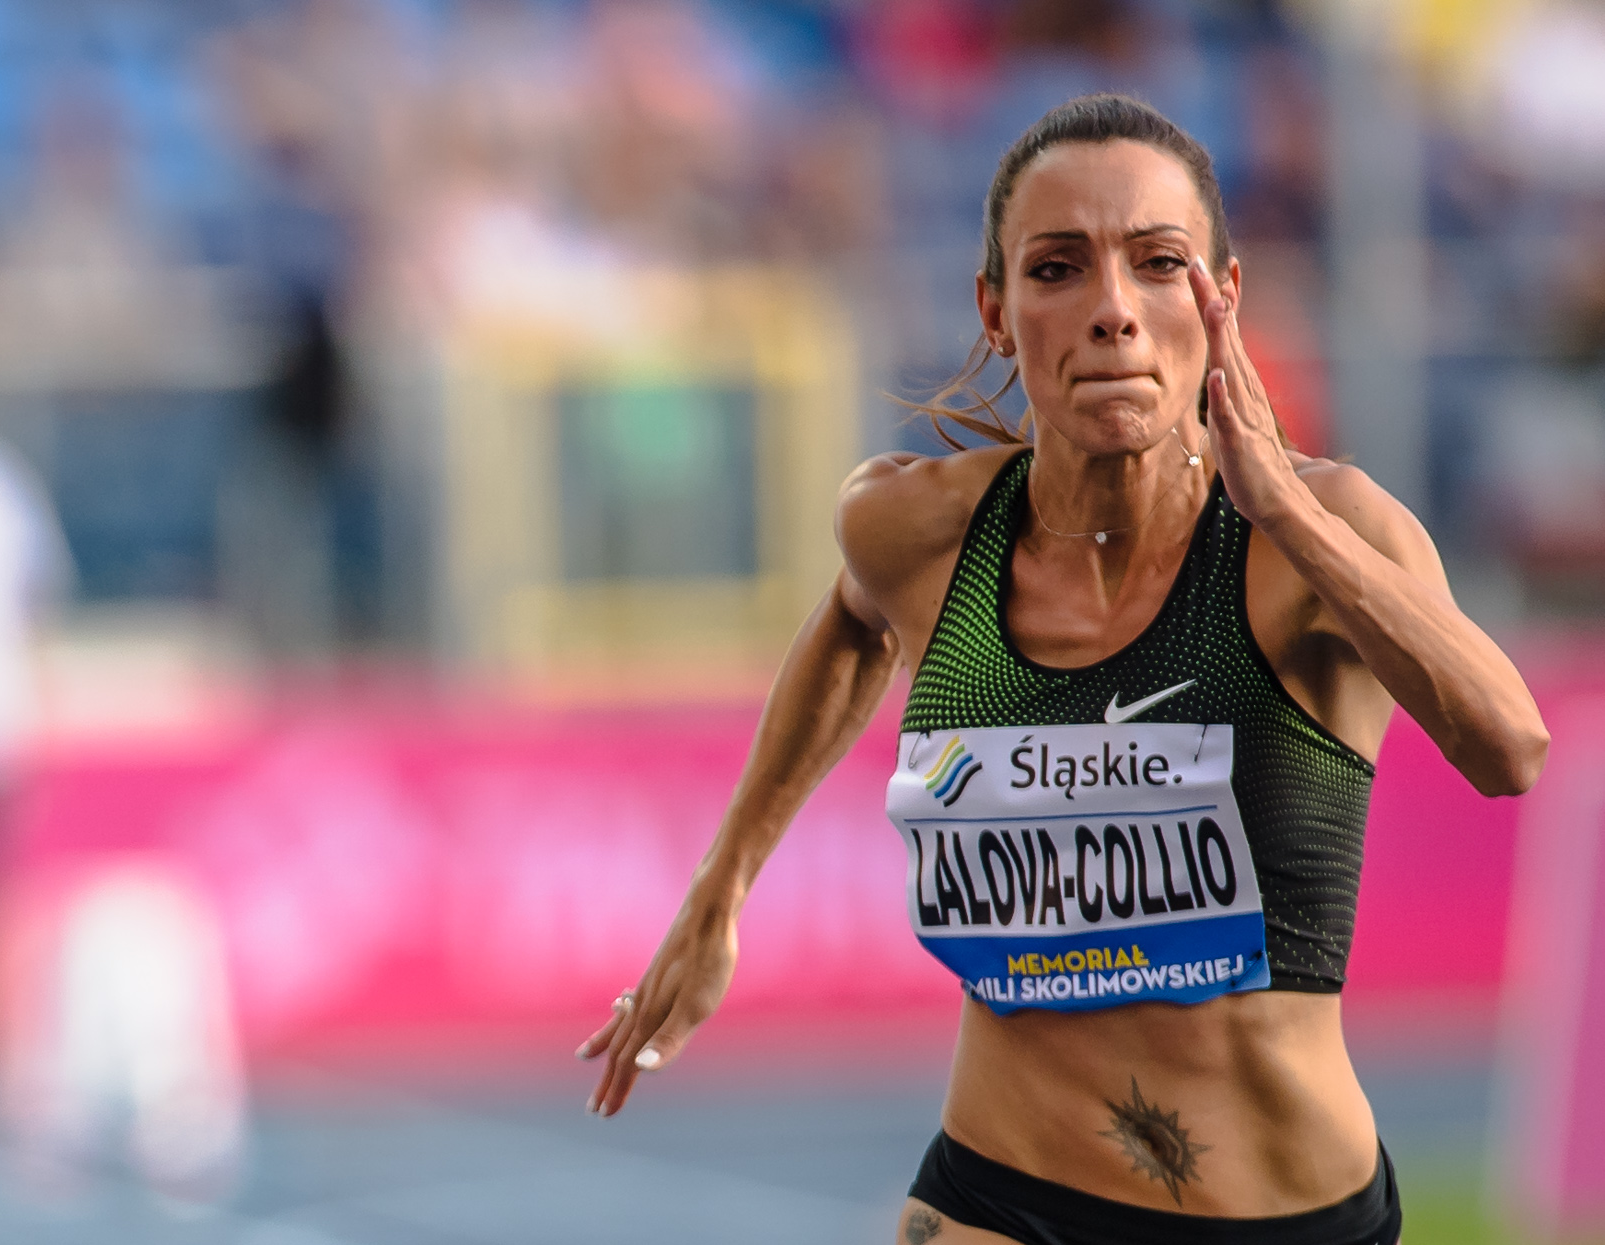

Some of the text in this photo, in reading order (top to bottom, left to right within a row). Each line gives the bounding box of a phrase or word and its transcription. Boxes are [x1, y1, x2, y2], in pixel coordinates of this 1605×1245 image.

[1009, 734, 1183, 800] Śląskie.
[910, 816, 1237, 927] LALOVA-COLLIO
[963, 953, 1244, 1002] MILI SKOLIMOWSKIEJ
[1007, 944, 1150, 975] MEMORIAŁ
